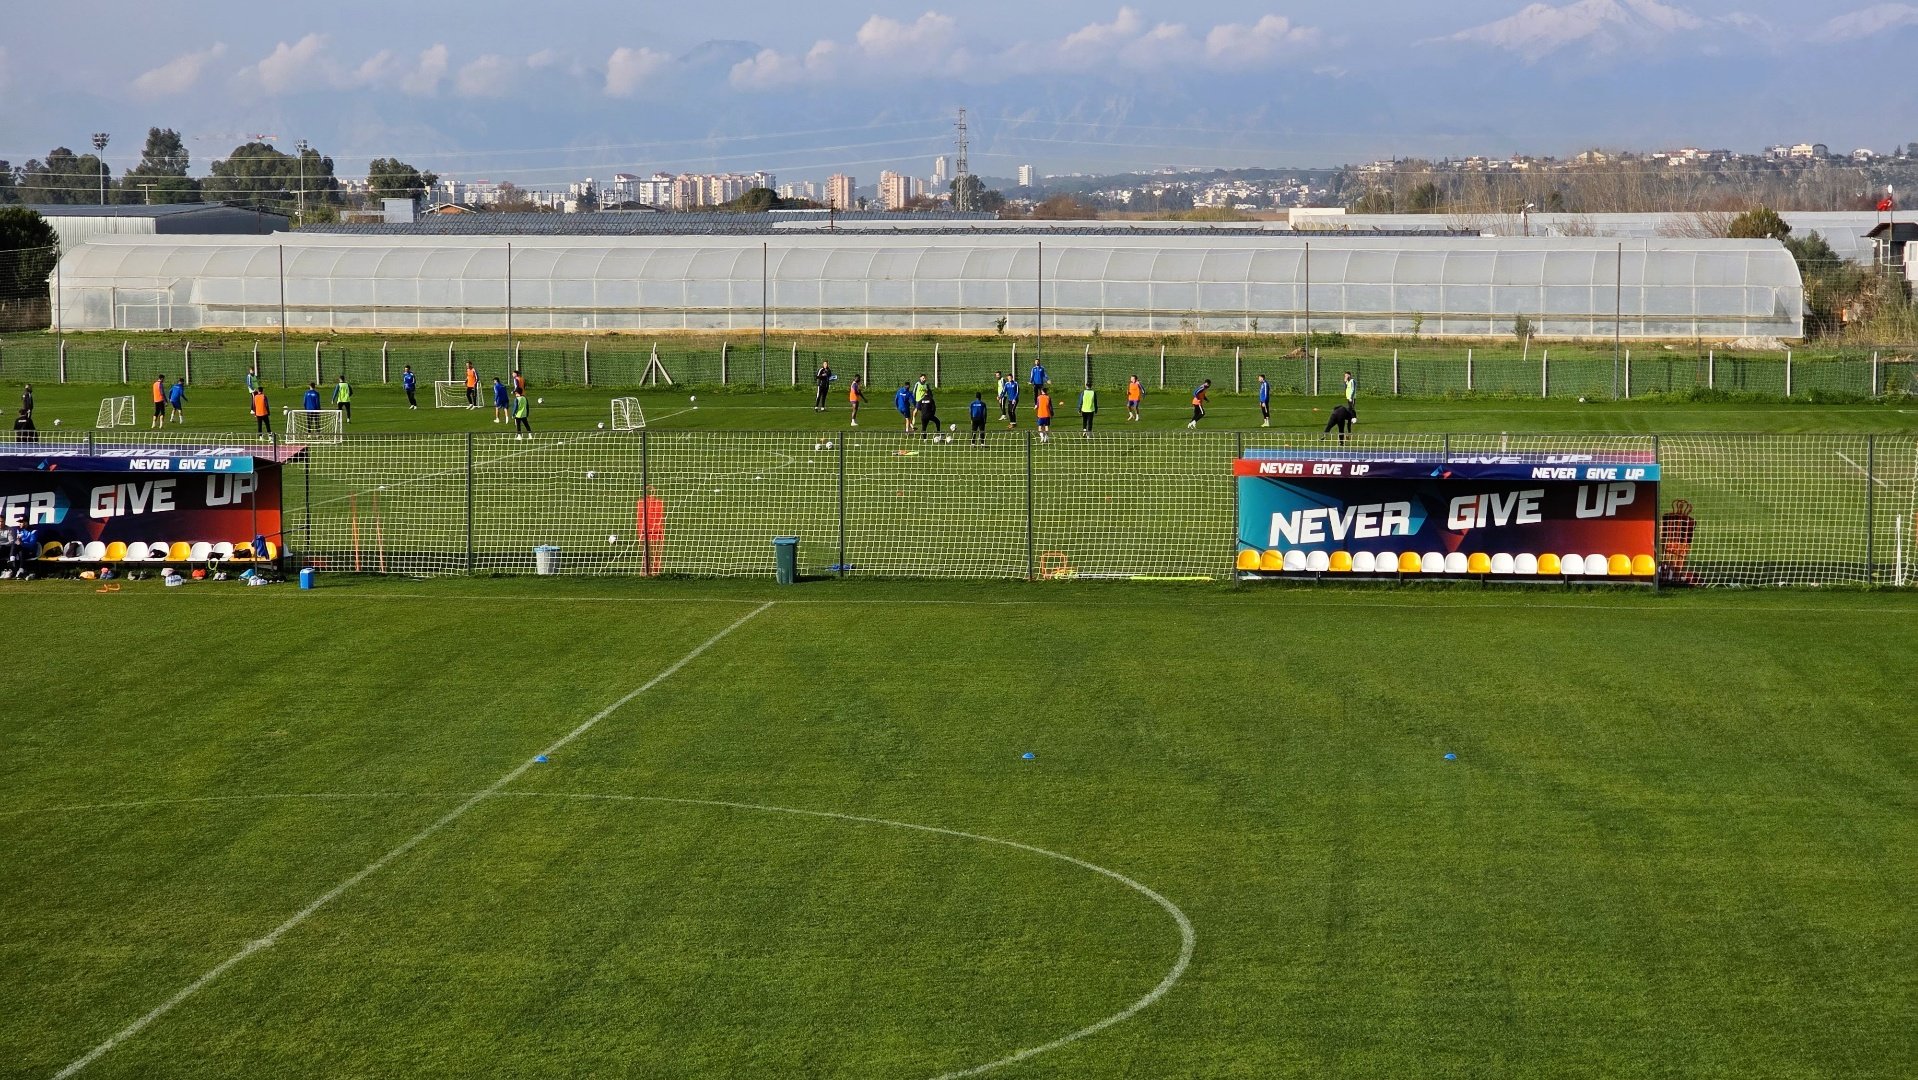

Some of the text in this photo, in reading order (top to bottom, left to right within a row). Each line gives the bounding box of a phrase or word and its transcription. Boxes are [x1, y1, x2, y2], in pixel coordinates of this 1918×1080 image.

[194, 447, 245, 456] UP
[129, 459, 232, 470] NEVER GIVE UP
[1546, 453, 1592, 464] UP
[1259, 462, 1370, 476] NEVER GIVE UP
[1531, 467, 1645, 480] NEVER GIVE UP
[89, 478, 177, 519] GIVE
[205, 474, 259, 507] UP
[1268, 482, 1636, 547] NEVER GIVE UP
